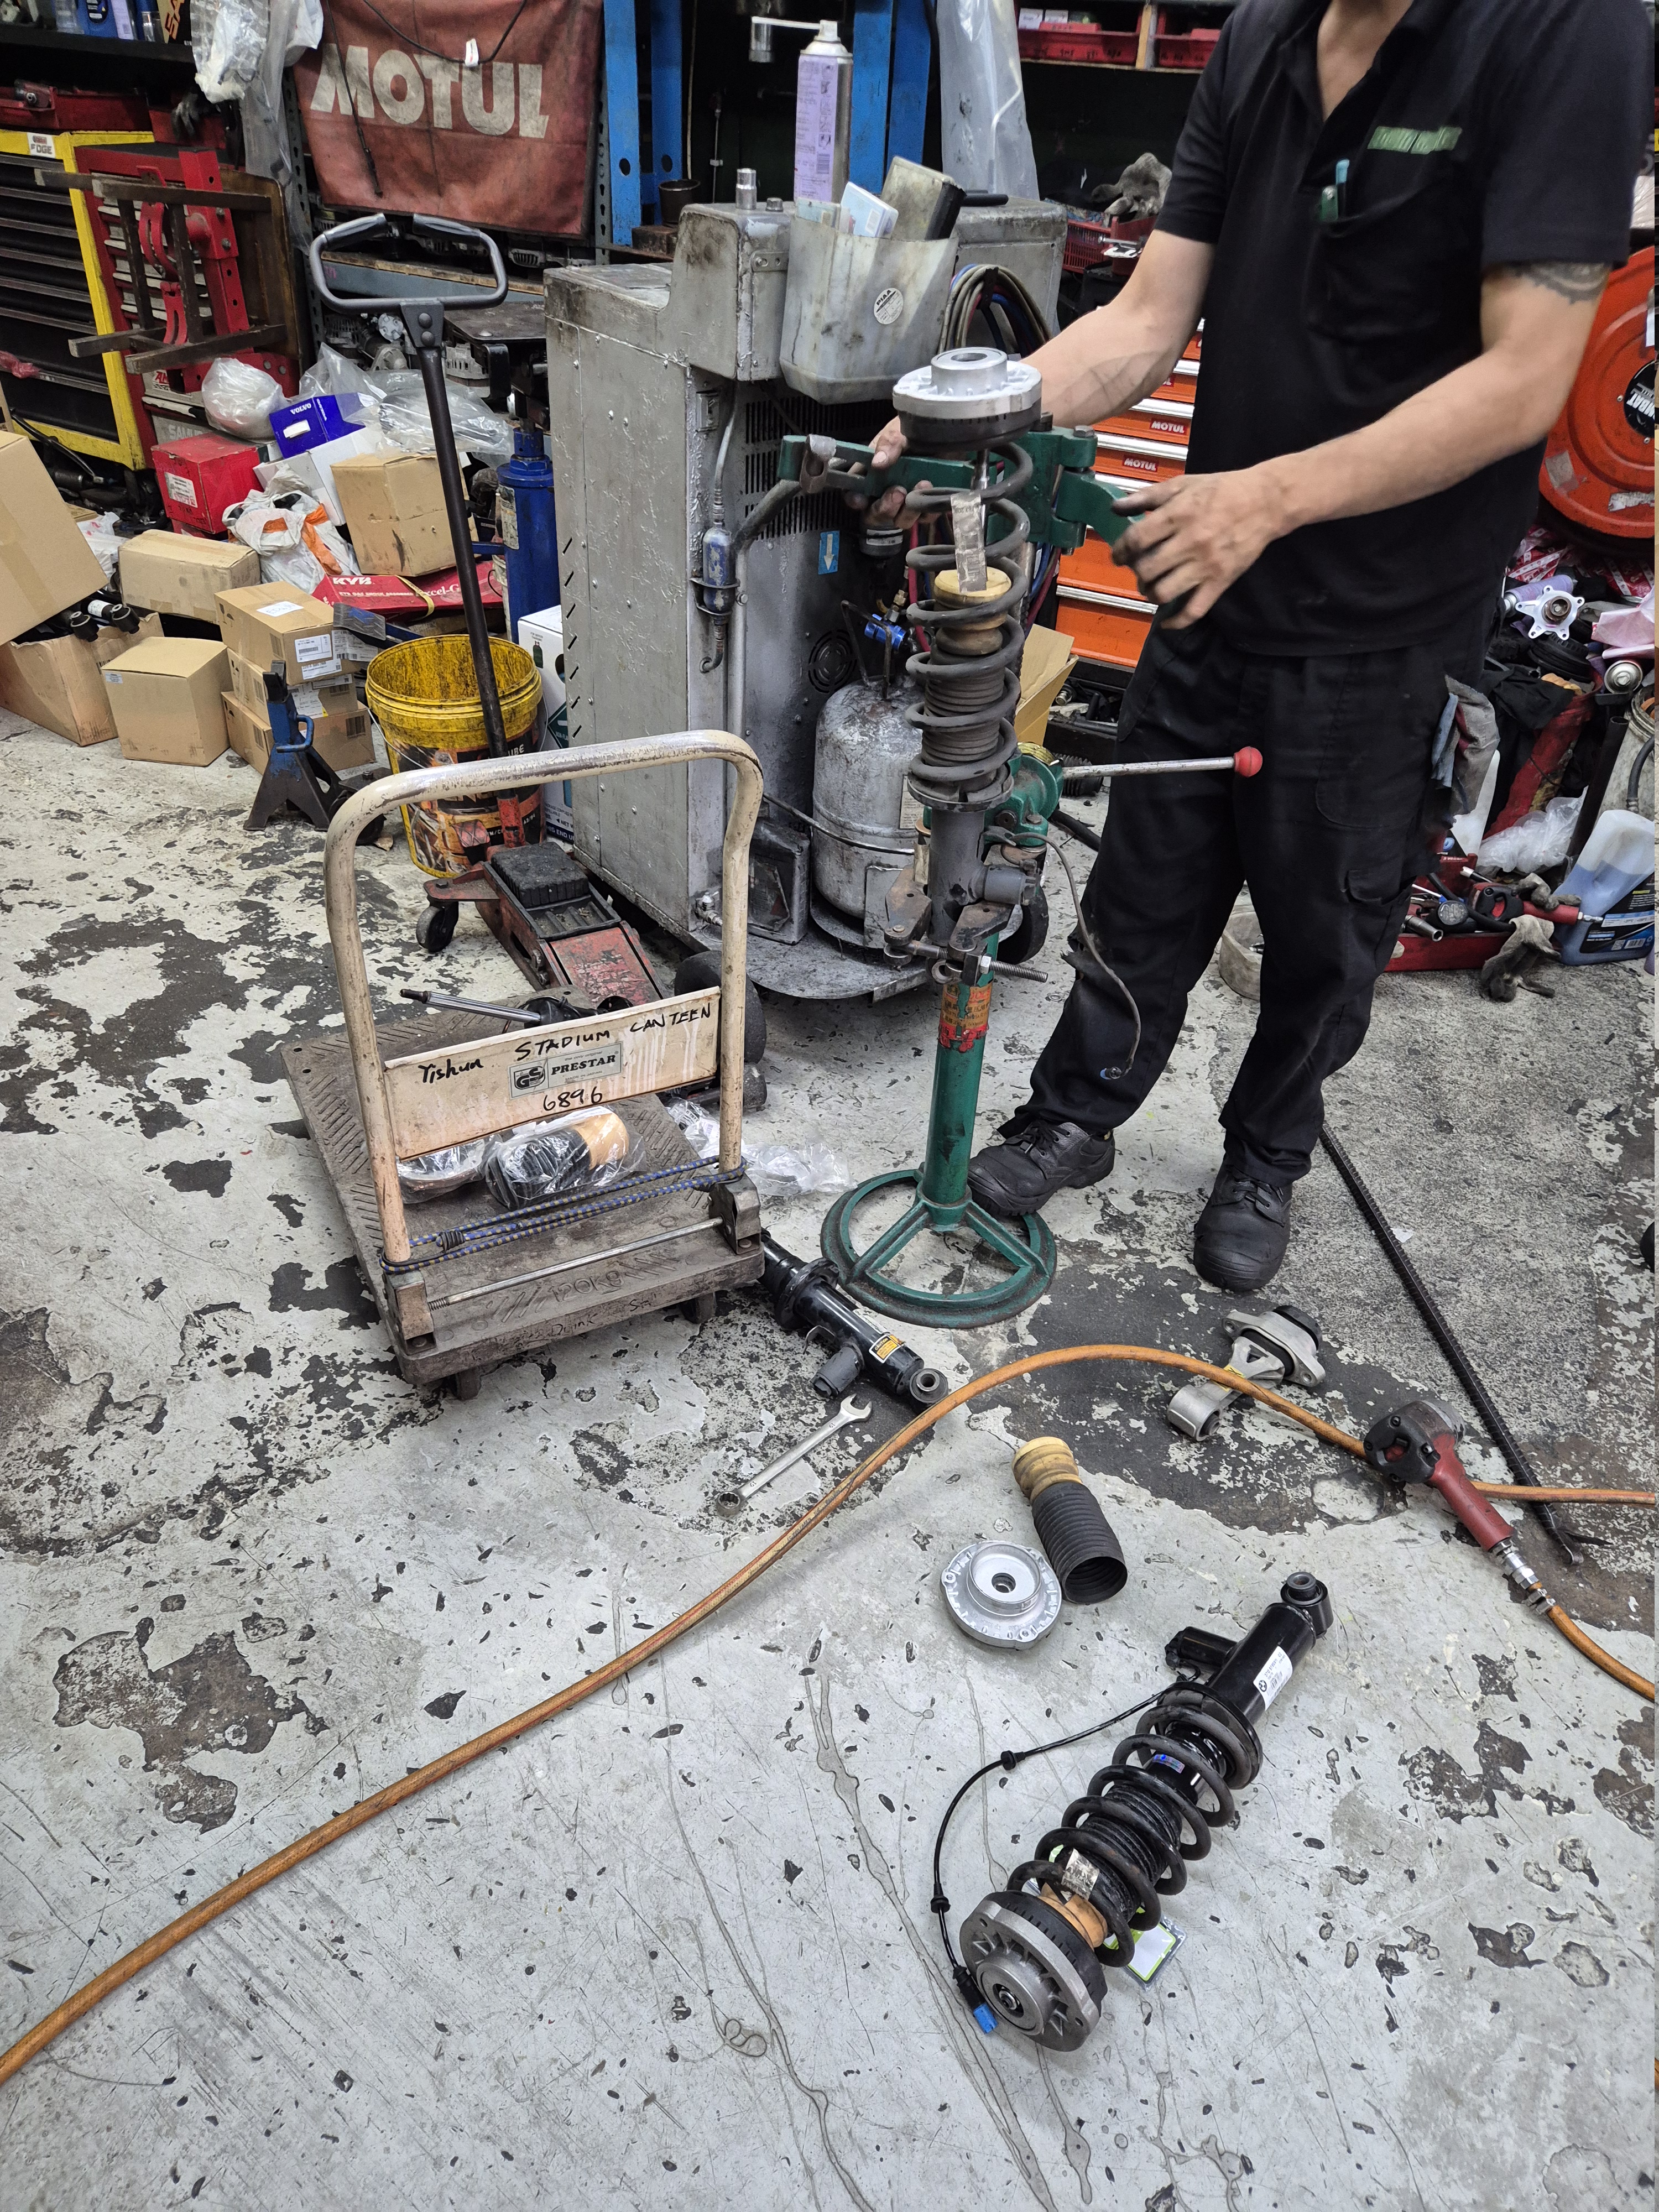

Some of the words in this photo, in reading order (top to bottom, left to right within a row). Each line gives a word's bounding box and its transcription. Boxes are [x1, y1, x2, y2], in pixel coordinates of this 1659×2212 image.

[310, 43, 549, 139] MOTUL
[876, 290, 891, 306] PIAA
[290, 403, 311, 415] VOLVO
[1626, 392, 1655, 421] MBAT
[1151, 420, 1185, 434] MOTUL
[1124, 457, 1157, 471] MOTUL
[333, 577, 372, 585] KYB
[416, 583, 460, 597] xcel-G
[508, 743, 525, 757] UBE
[556, 830, 568, 838] END
[514, 1030, 611, 1062] STADIUM
[550, 1055, 617, 1076] PRESTAR
[542, 1086, 603, 1112] 6896
